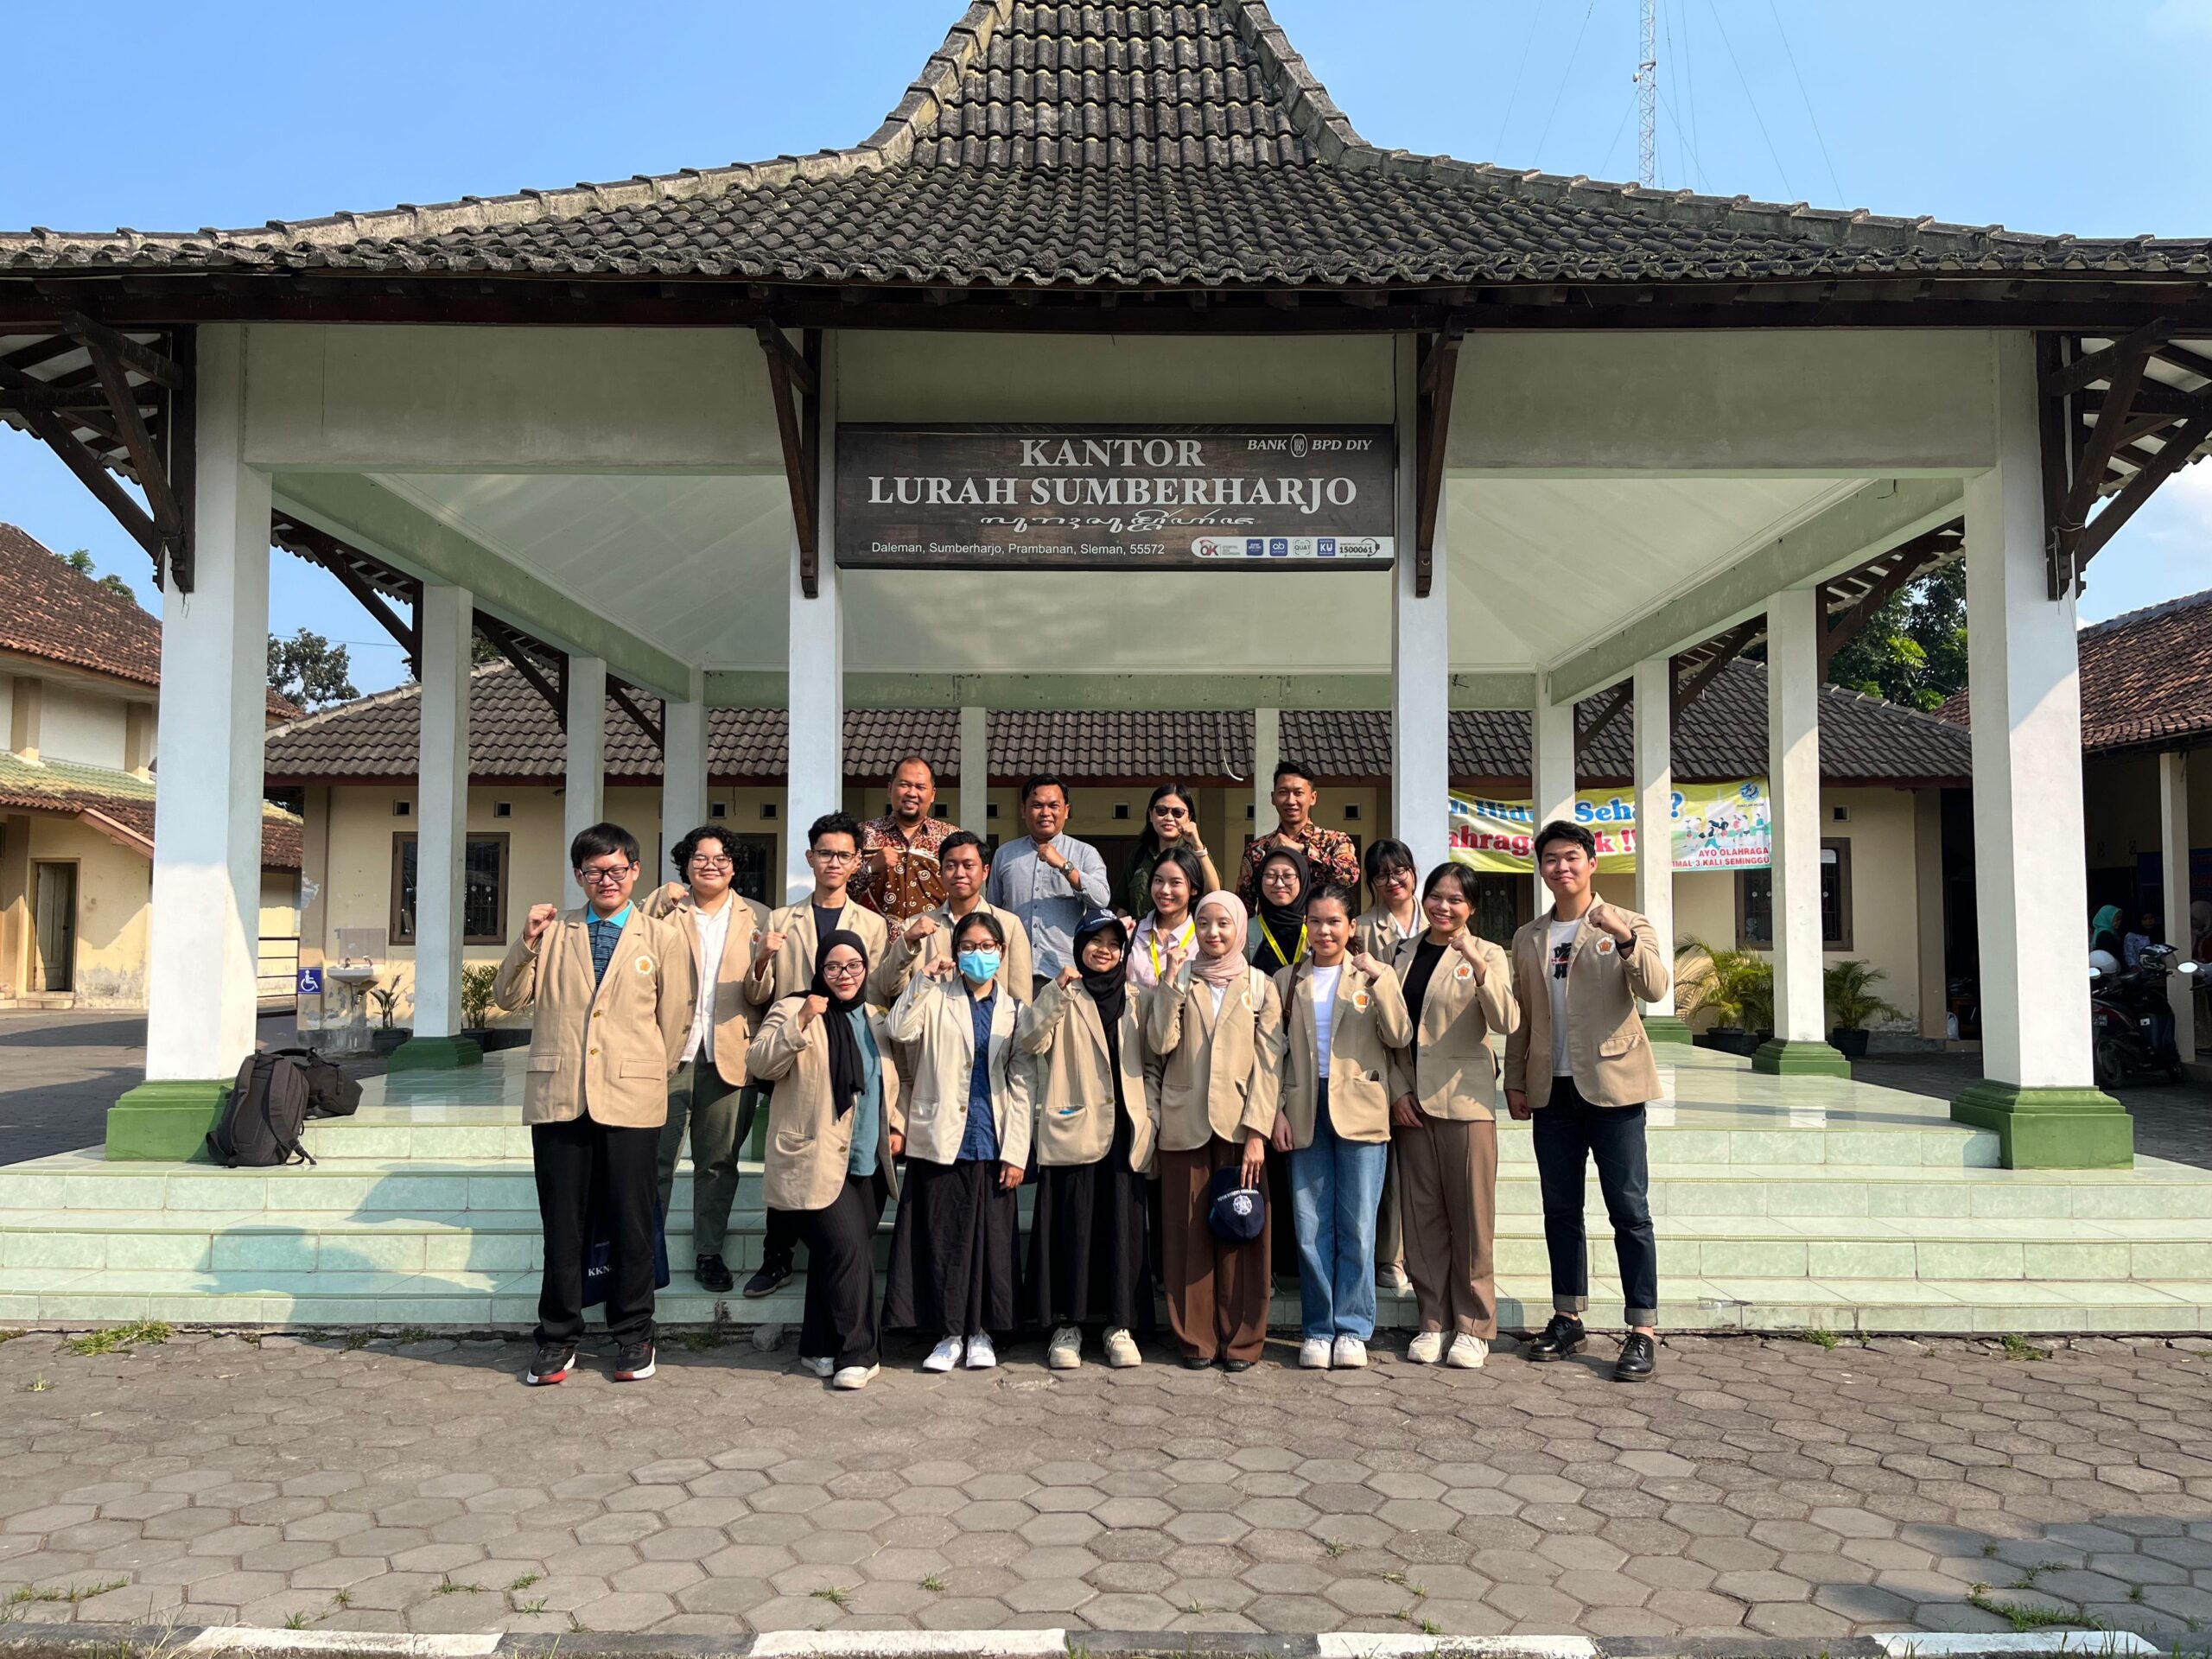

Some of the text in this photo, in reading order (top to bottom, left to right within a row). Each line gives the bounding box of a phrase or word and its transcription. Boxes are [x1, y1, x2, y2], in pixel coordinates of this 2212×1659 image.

[1247, 439, 1372, 450] BANK BPD DIY
[1020, 439, 1206, 467] KANTOR
[868, 476, 1357, 513] LURAH SUMBERHARJO
[872, 542, 1165, 556] Daleman, Sumberharjo, Prambanan, Sleman, 55572
[1319, 543, 1333, 552] KU
[1699, 847, 1769, 857] AYO OLAHRAGA
[1725, 856, 1770, 865] SEMINGGU
[588, 1264, 610, 1277] KKN
